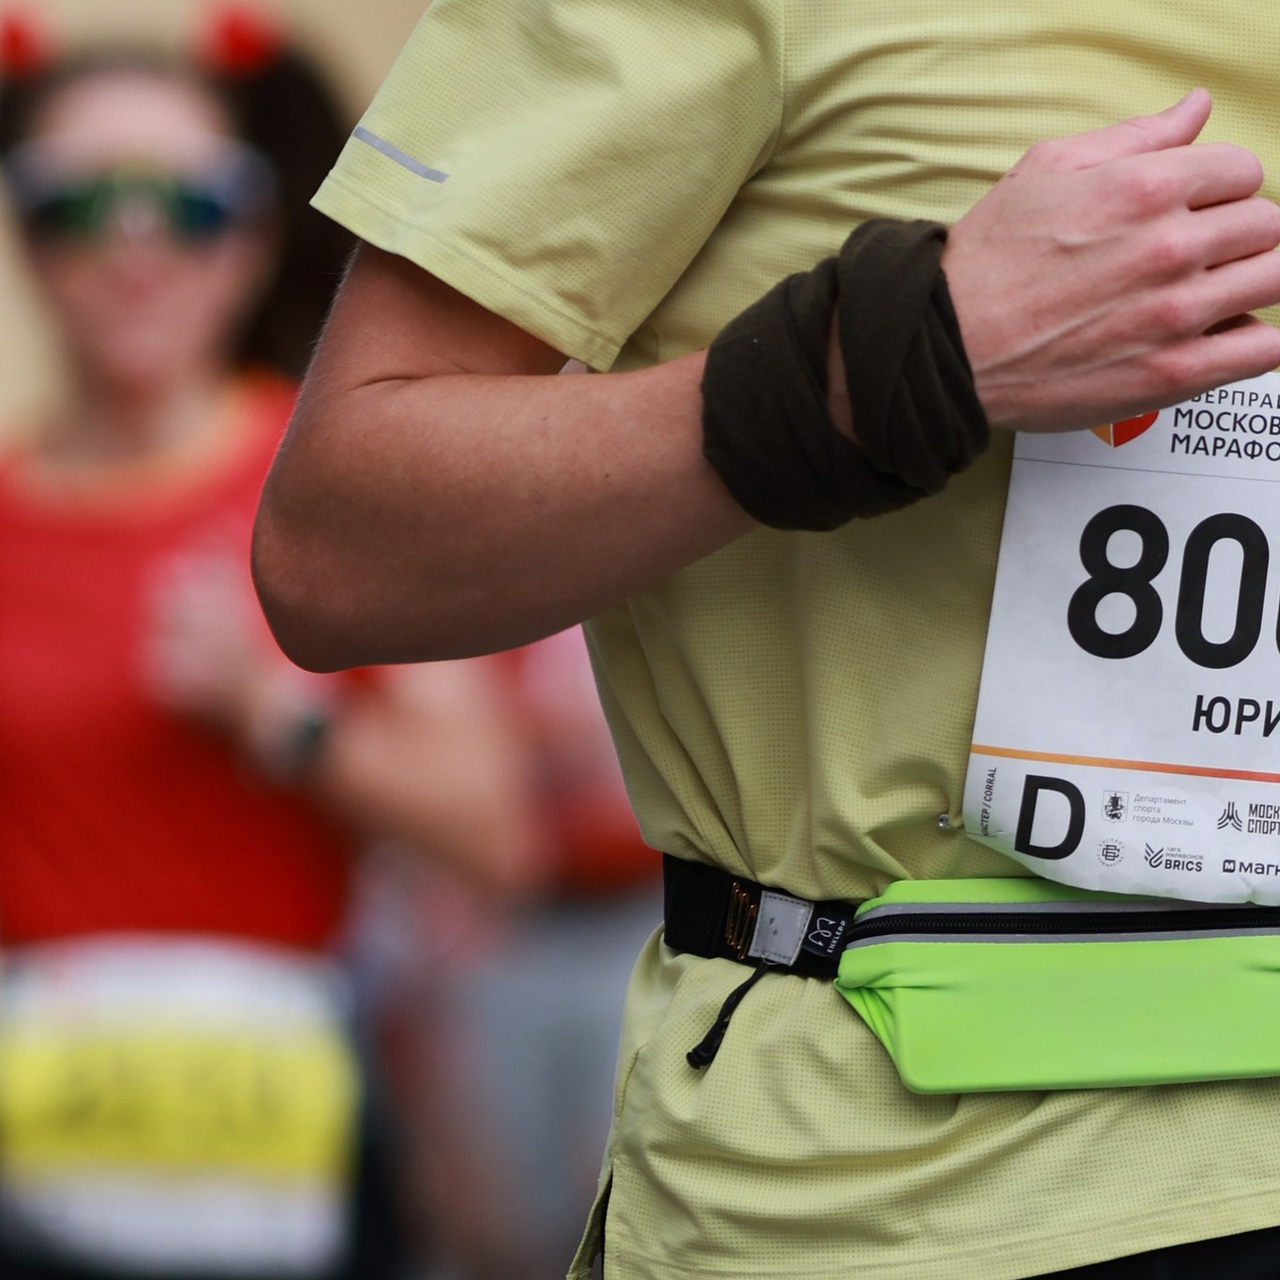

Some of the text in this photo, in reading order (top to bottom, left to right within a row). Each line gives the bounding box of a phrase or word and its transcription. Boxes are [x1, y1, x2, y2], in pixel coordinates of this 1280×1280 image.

[983, 767, 997, 802] CORRAL
[1133, 794, 1188, 806] Департамент
[1132, 805, 1161, 814] спорта
[1014, 773, 1086, 861] D
[1132, 814, 1194, 827] города Москвы
[1164, 859, 1203, 872] BRICS
